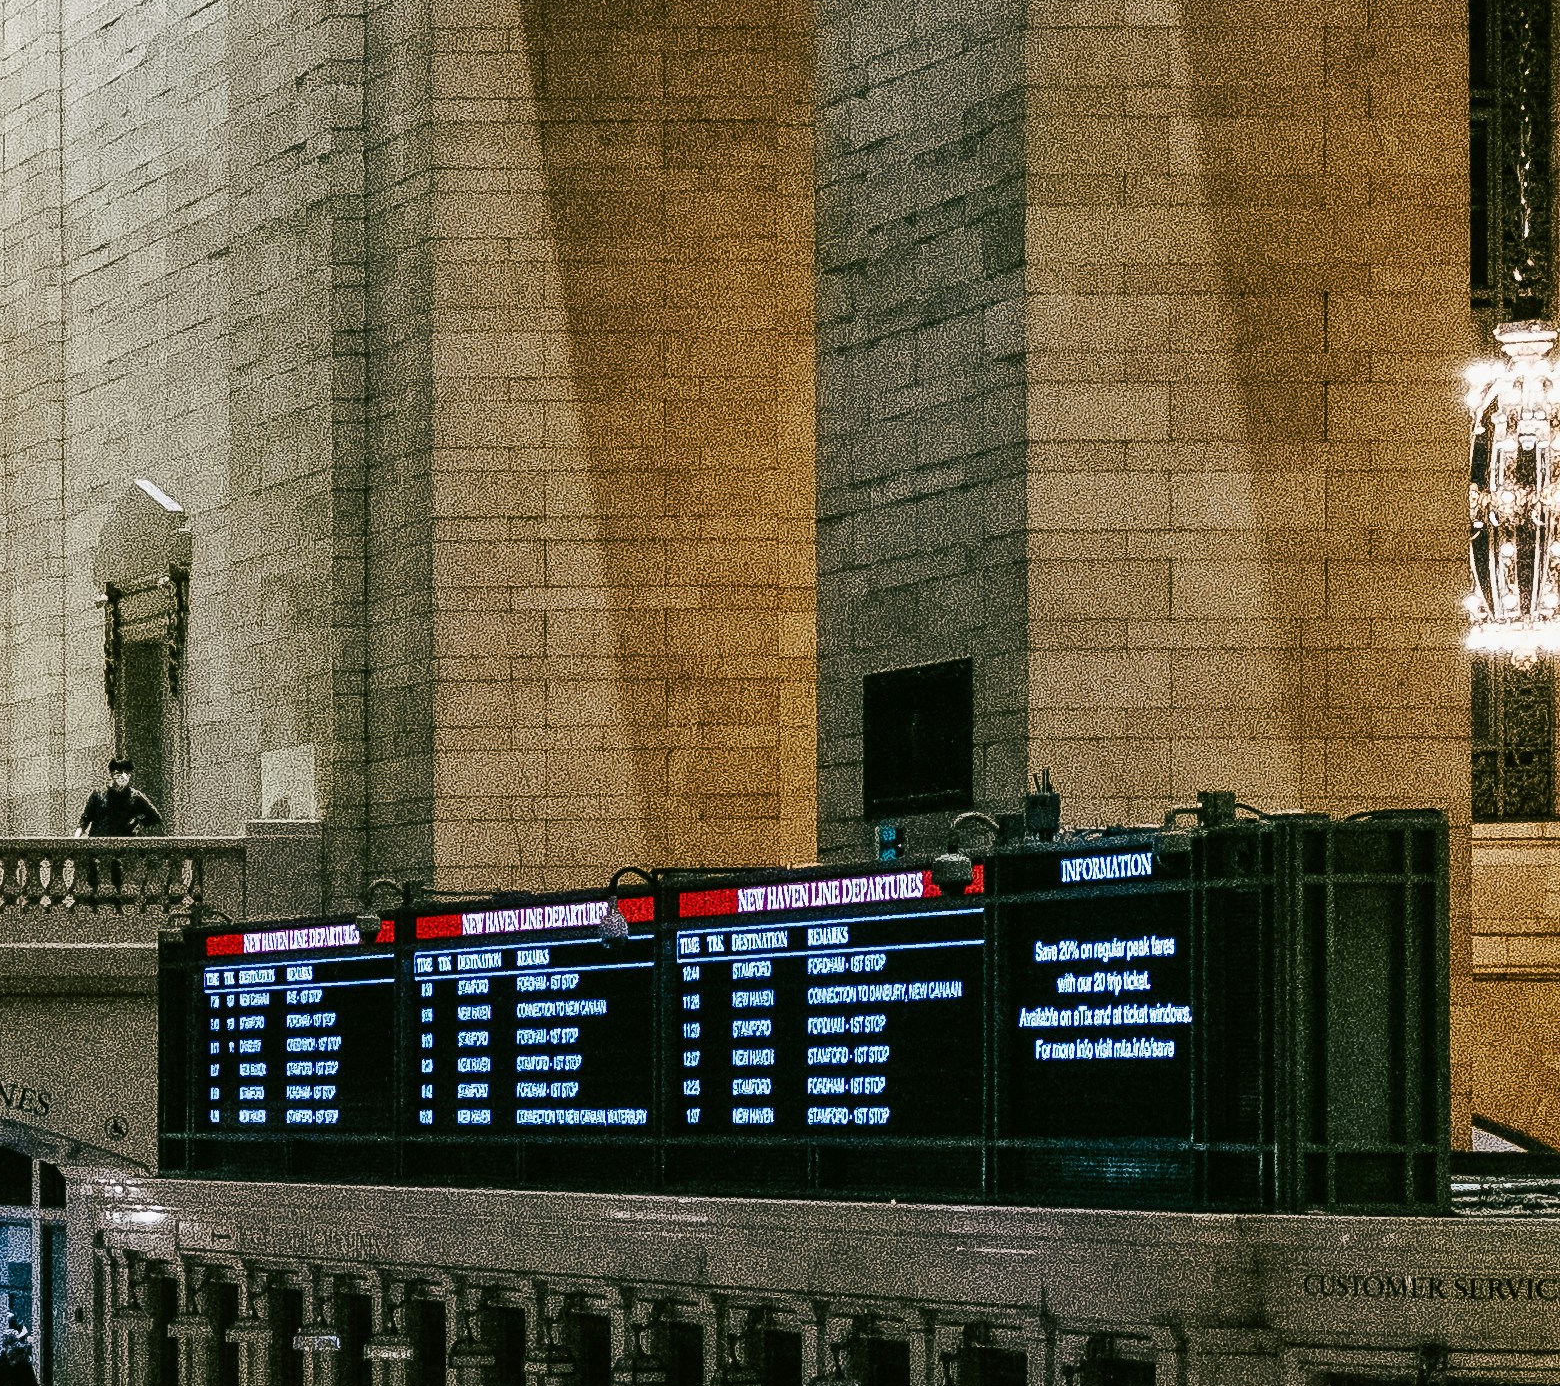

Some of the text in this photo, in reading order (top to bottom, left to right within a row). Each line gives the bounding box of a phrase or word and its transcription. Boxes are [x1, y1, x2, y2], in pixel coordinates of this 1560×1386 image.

[1062, 853, 1152, 882] INFORMATION
[738, 872, 923, 913] NEW HAVEN LINE DEPARTURES
[462, 914, 484, 935] NEW
[485, 911, 519, 933] HAVEN
[520, 907, 543, 931] LINE
[732, 931, 787, 951] DESTINATION
[807, 926, 849, 947] REMARKS
[1035, 935, 1175, 962] Save 20% on regular peak fares
[1057, 973, 1076, 993] with
[1077, 977, 1092, 992] our
[1094, 972, 1105, 992] 20
[1107, 971, 1122, 996] trip
[1019, 1007, 1058, 1027] Available
[1060, 1010, 1071, 1026] on
[1094, 1005, 1111, 1026] and
[1113, 1005, 1122, 1025] at
[1123, 1004, 1148, 1024] ticket
[1035, 1039, 1051, 1060] For
[1052, 1043, 1075, 1059] more
[1076, 1039, 1093, 1059] info
[1095, 1038, 1112, 1058] visit
[1303, 1272, 1447, 1298] CUSTOMER
